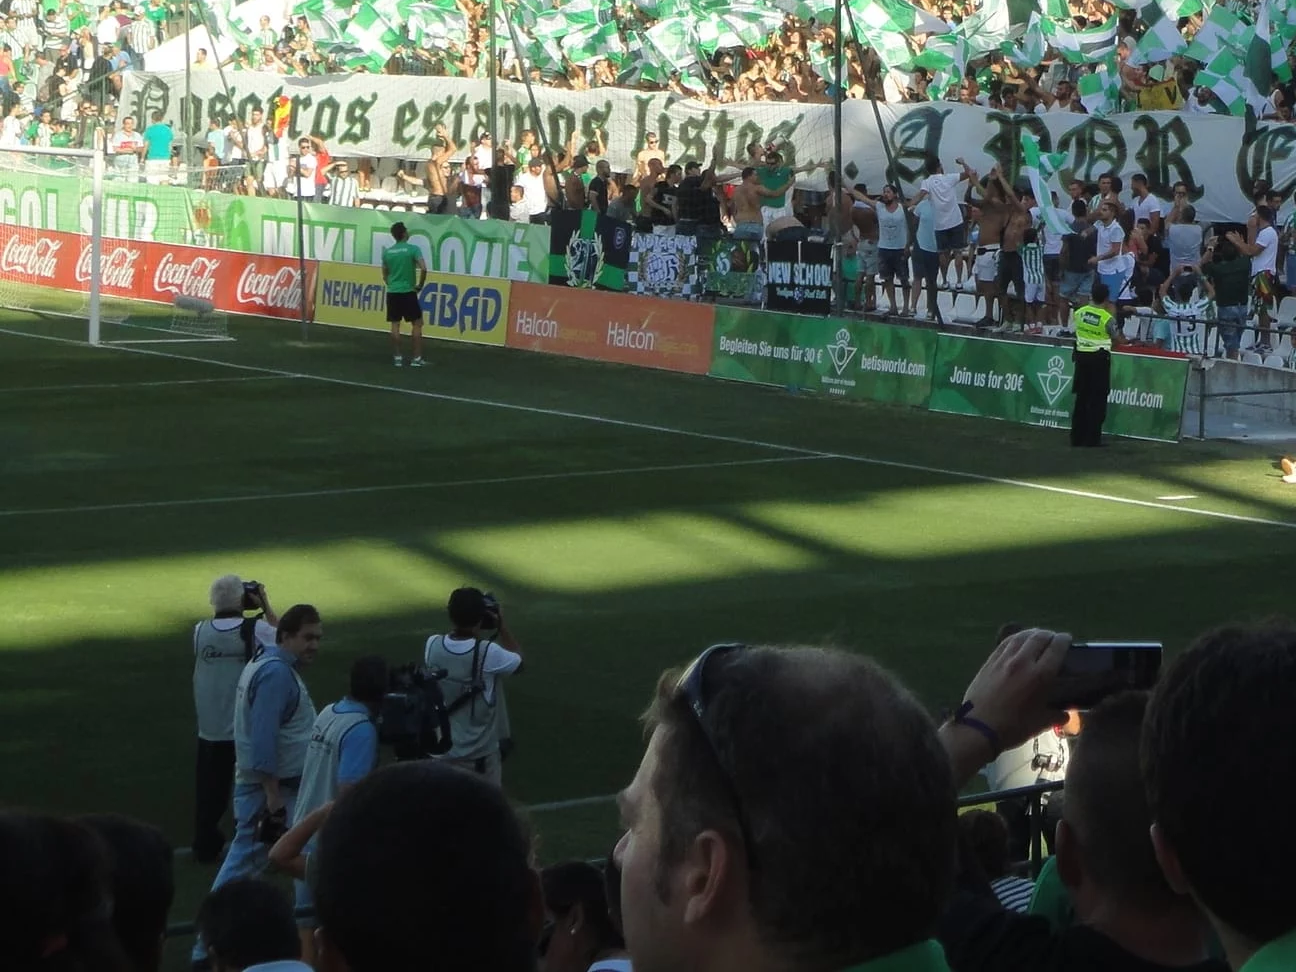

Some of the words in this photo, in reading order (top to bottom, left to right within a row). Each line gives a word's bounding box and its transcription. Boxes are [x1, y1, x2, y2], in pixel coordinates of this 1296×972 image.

[768, 261, 792, 285] NEW
[793, 262, 832, 287] SCHOOL
[418, 282, 502, 334] ABAD
[719, 335, 758, 356] Begleiten
[759, 340, 772, 357] Sie
[773, 346, 790, 361] uns
[804, 347, 816, 364] 30
[860, 354, 926, 378] betisworld.com
[950, 365, 971, 386] Join
[973, 371, 986, 386] us
[988, 369, 1003, 389] for
[1107, 387, 1164, 409] world.com
